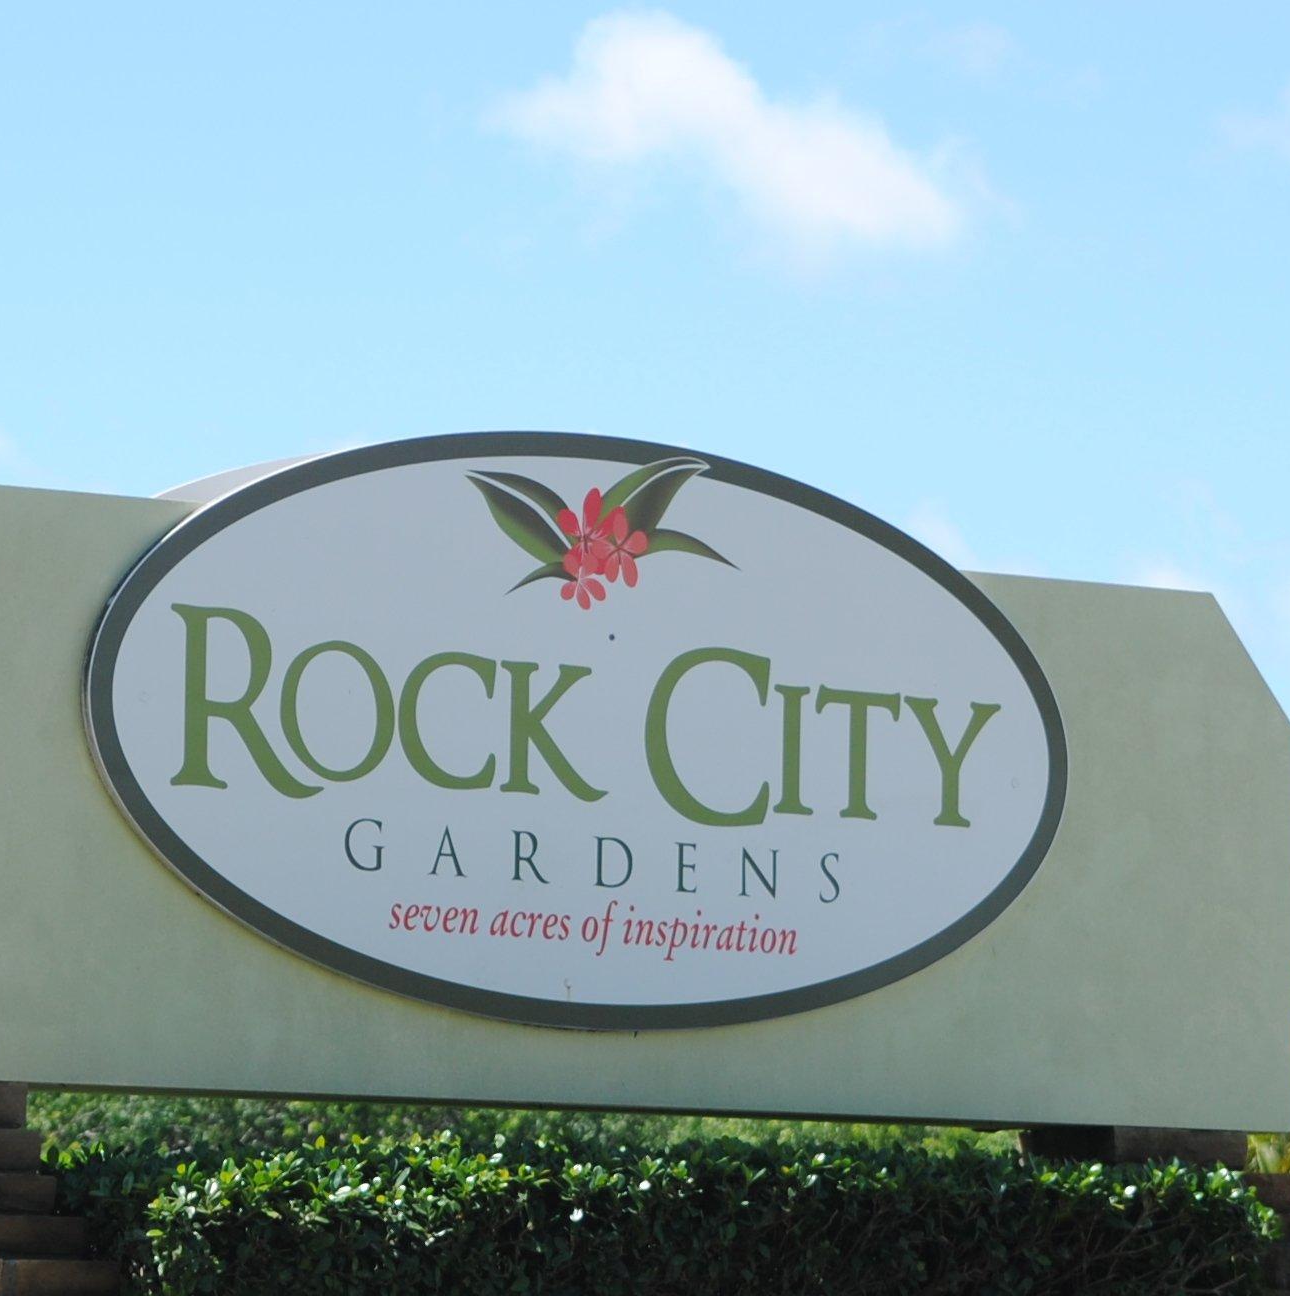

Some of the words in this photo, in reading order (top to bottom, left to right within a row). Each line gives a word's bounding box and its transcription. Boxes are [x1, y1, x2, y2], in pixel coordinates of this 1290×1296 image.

[171, 603, 608, 802] ROCK
[644, 646, 1001, 827] CITY
[343, 818, 841, 904] GARDENS
[388, 903, 482, 935] seven
[490, 907, 570, 942] acres
[580, 900, 618, 955] of
[621, 906, 799, 962] inspiration
